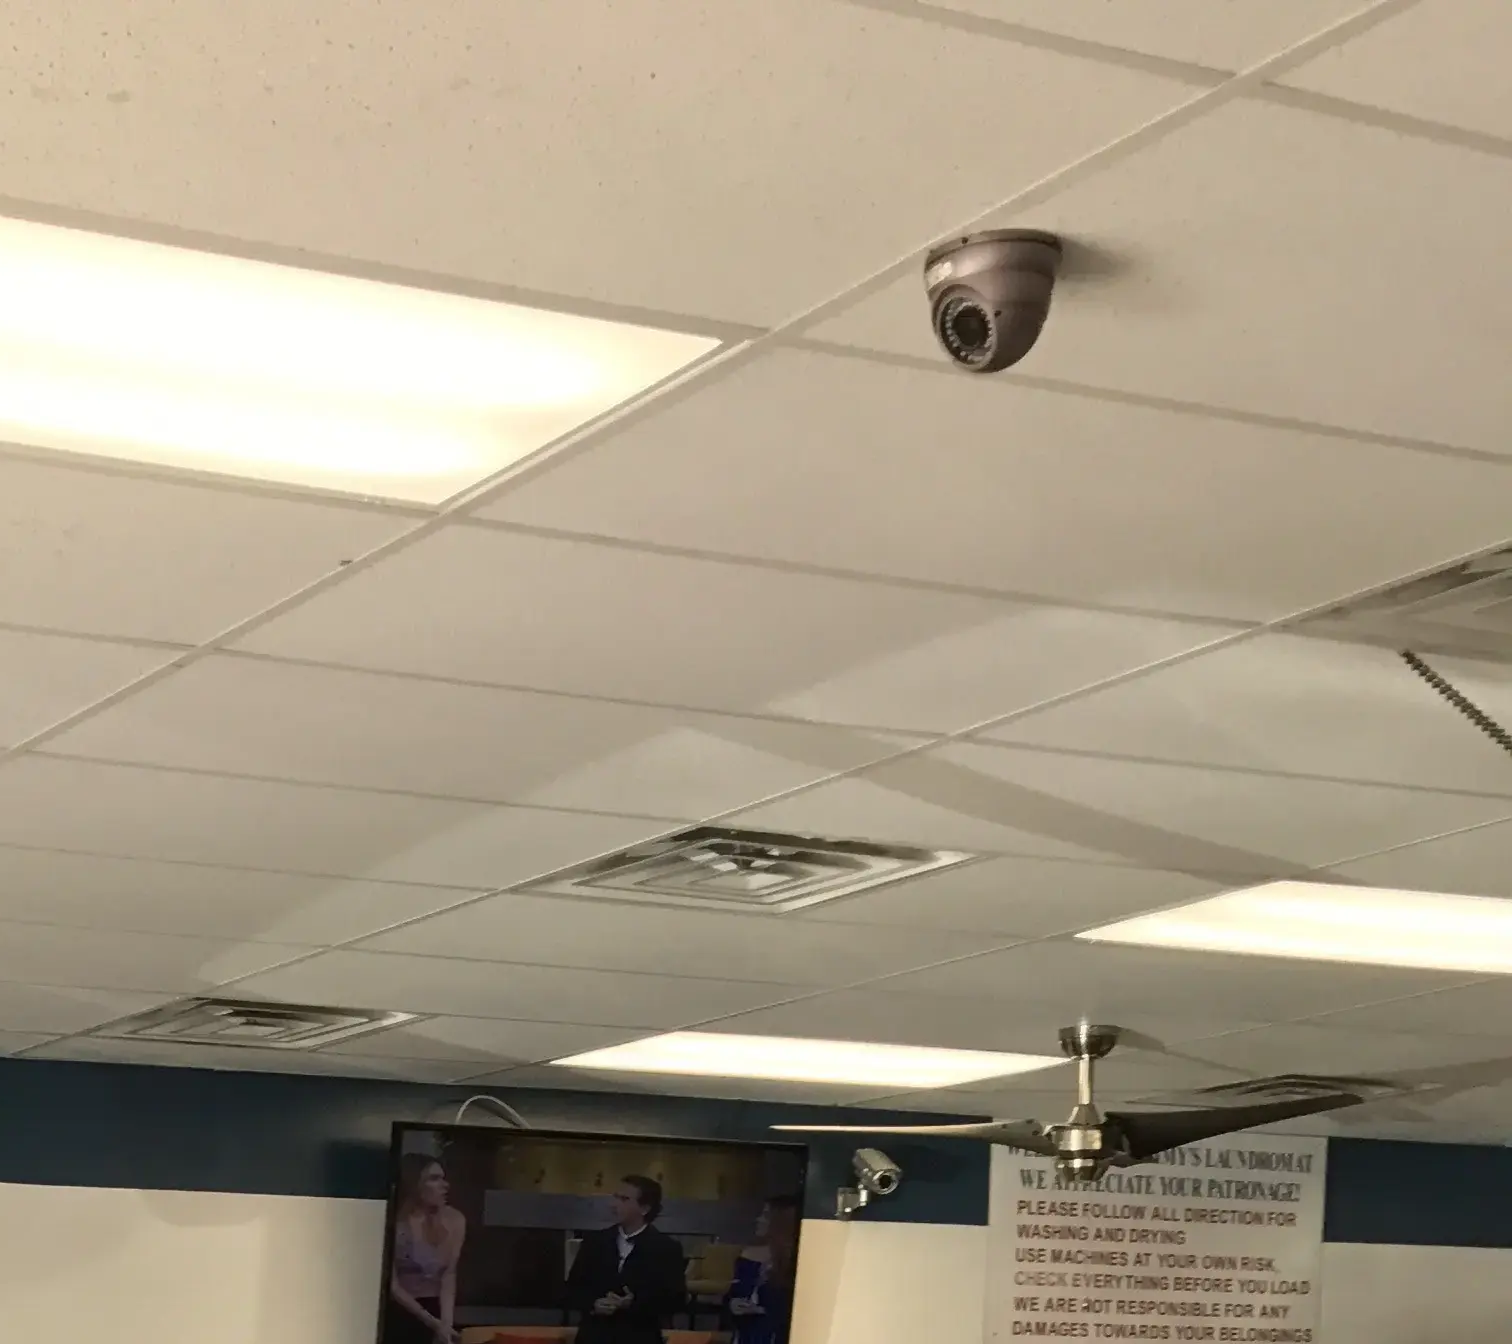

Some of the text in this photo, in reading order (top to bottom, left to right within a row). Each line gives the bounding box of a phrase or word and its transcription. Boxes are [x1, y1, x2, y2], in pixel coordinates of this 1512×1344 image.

[1205, 1148, 1313, 1174] LAUNDROMAT
[1020, 1168, 1047, 1190] WE
[1159, 1176, 1203, 1198] YOUR
[1016, 1200, 1297, 1227] PLEASE FOLLOW ALL DIRECTION FOR
[1016, 1224, 1186, 1245] WASHING AND DRYING
[1015, 1248, 1046, 1263] USE
[1050, 1249, 1129, 1266] MACHINES
[1133, 1252, 1152, 1267] AT
[1157, 1253, 1198, 1268] YOUR
[1202, 1255, 1237, 1270] OWN
[1014, 1271, 1311, 1295] CHECK EVERYTHING BEFORE YOU LOAD
[1013, 1296, 1291, 1319] WE ARE NOT RESPONSIBLE FOR ANY
[1012, 1321, 1312, 1343] DAMAGES TOWARDS YOUR BELONGINGS
